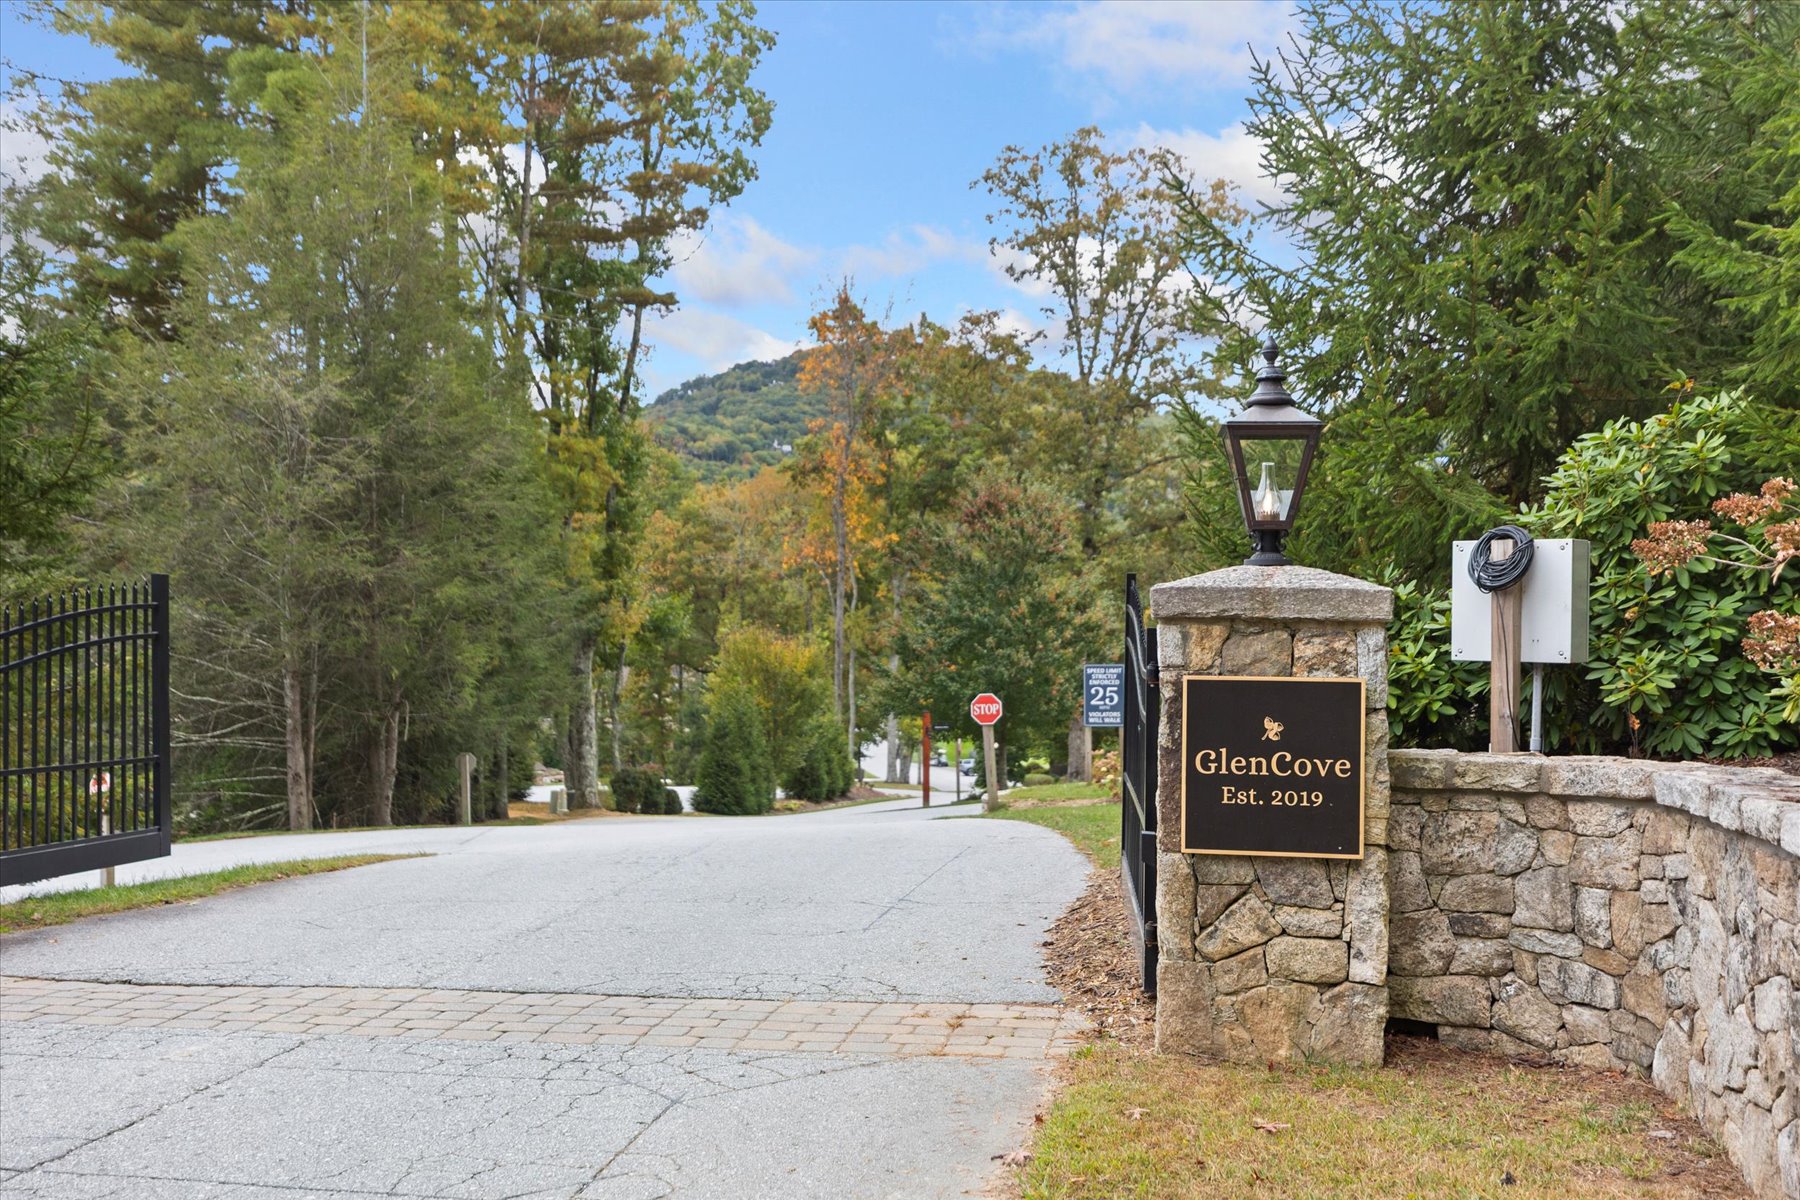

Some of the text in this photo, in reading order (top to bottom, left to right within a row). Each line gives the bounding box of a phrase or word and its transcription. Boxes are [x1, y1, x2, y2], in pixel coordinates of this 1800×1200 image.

[1090, 686, 1118, 705] 25
[974, 704, 999, 714] STOP
[1195, 748, 1351, 778] GlenCove
[1222, 786, 1323, 806] Est. 2019
